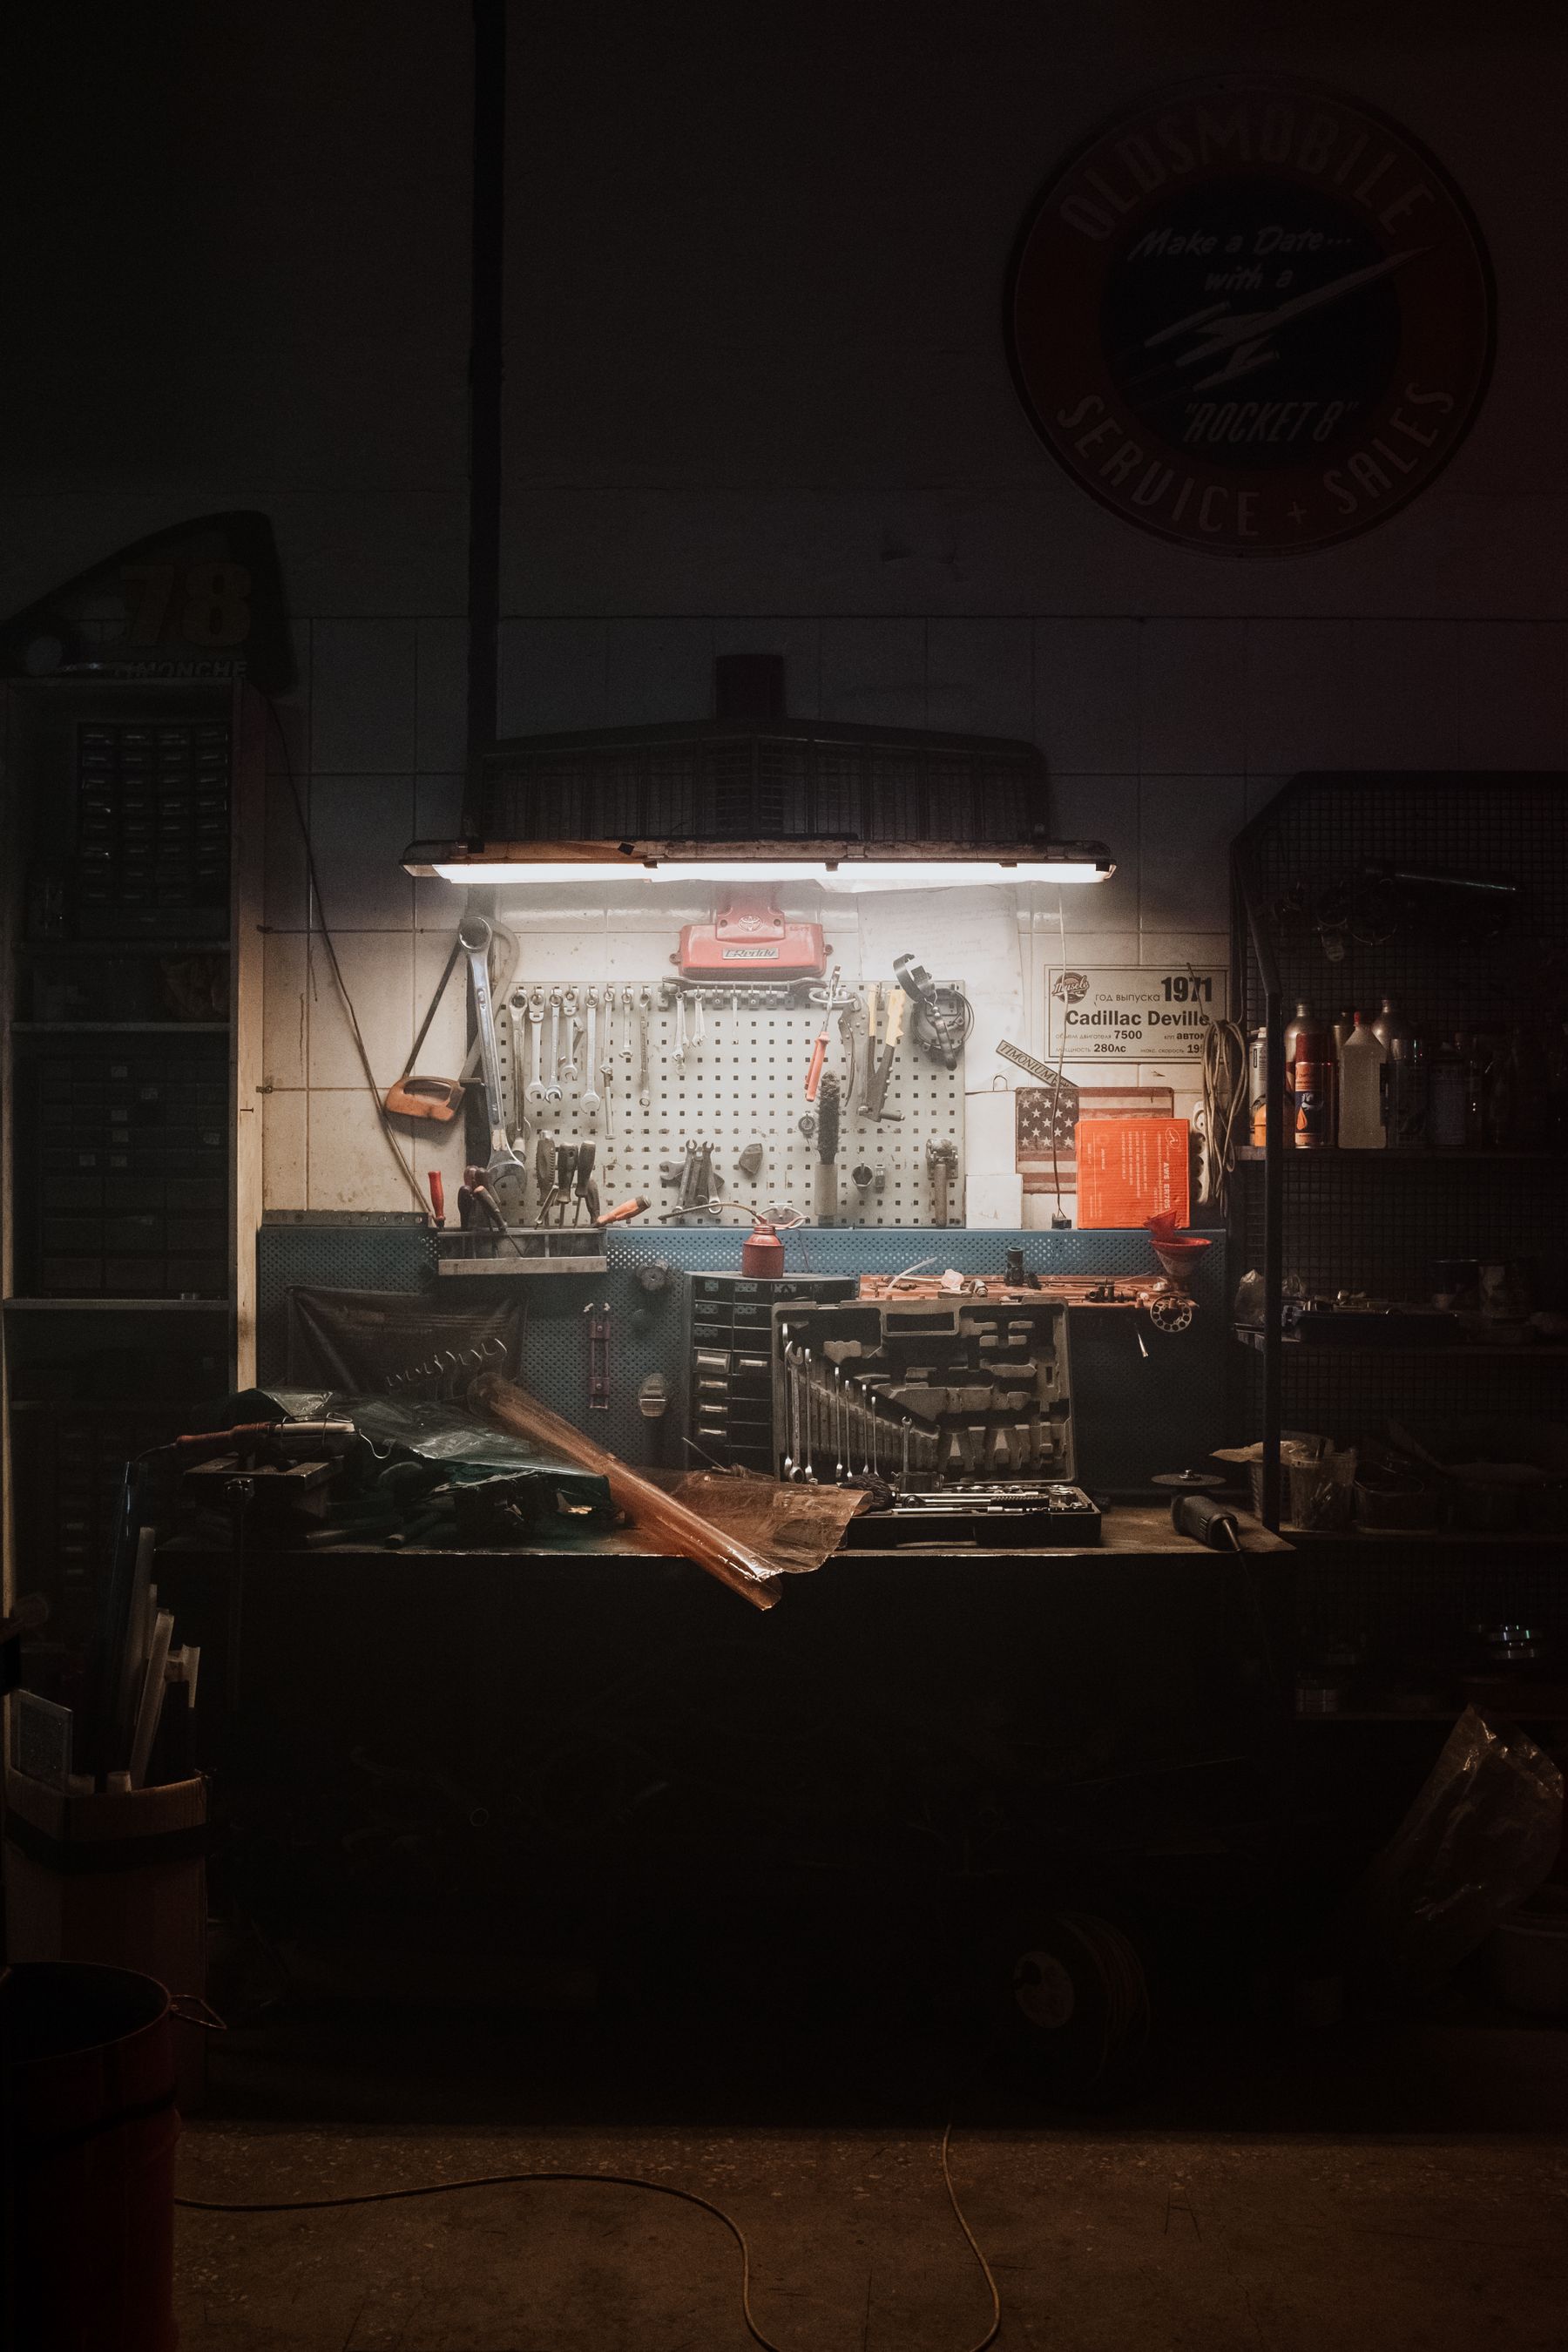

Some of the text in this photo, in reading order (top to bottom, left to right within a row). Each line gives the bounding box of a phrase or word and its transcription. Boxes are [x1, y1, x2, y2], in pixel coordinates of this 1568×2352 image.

[1059, 103, 1436, 242] OLDSMOBILE
[1127, 226, 1218, 260] Make
[1225, 235, 1242, 253] a
[1205, 263, 1294, 292] with a
[1058, 394, 1261, 537] SERVICE
[1322, 382, 1455, 517] SALES
[119, 561, 252, 647] 78
[1116, 994, 1160, 1004] выпуска
[1161, 977, 1213, 1003] 1971
[1065, 1010, 1211, 1026] Cadillac Deville
[1093, 1044, 1126, 1053] 280лс
[1114, 1030, 1143, 1040] 7500
[999, 1043, 1055, 1081] TIMONIUM
